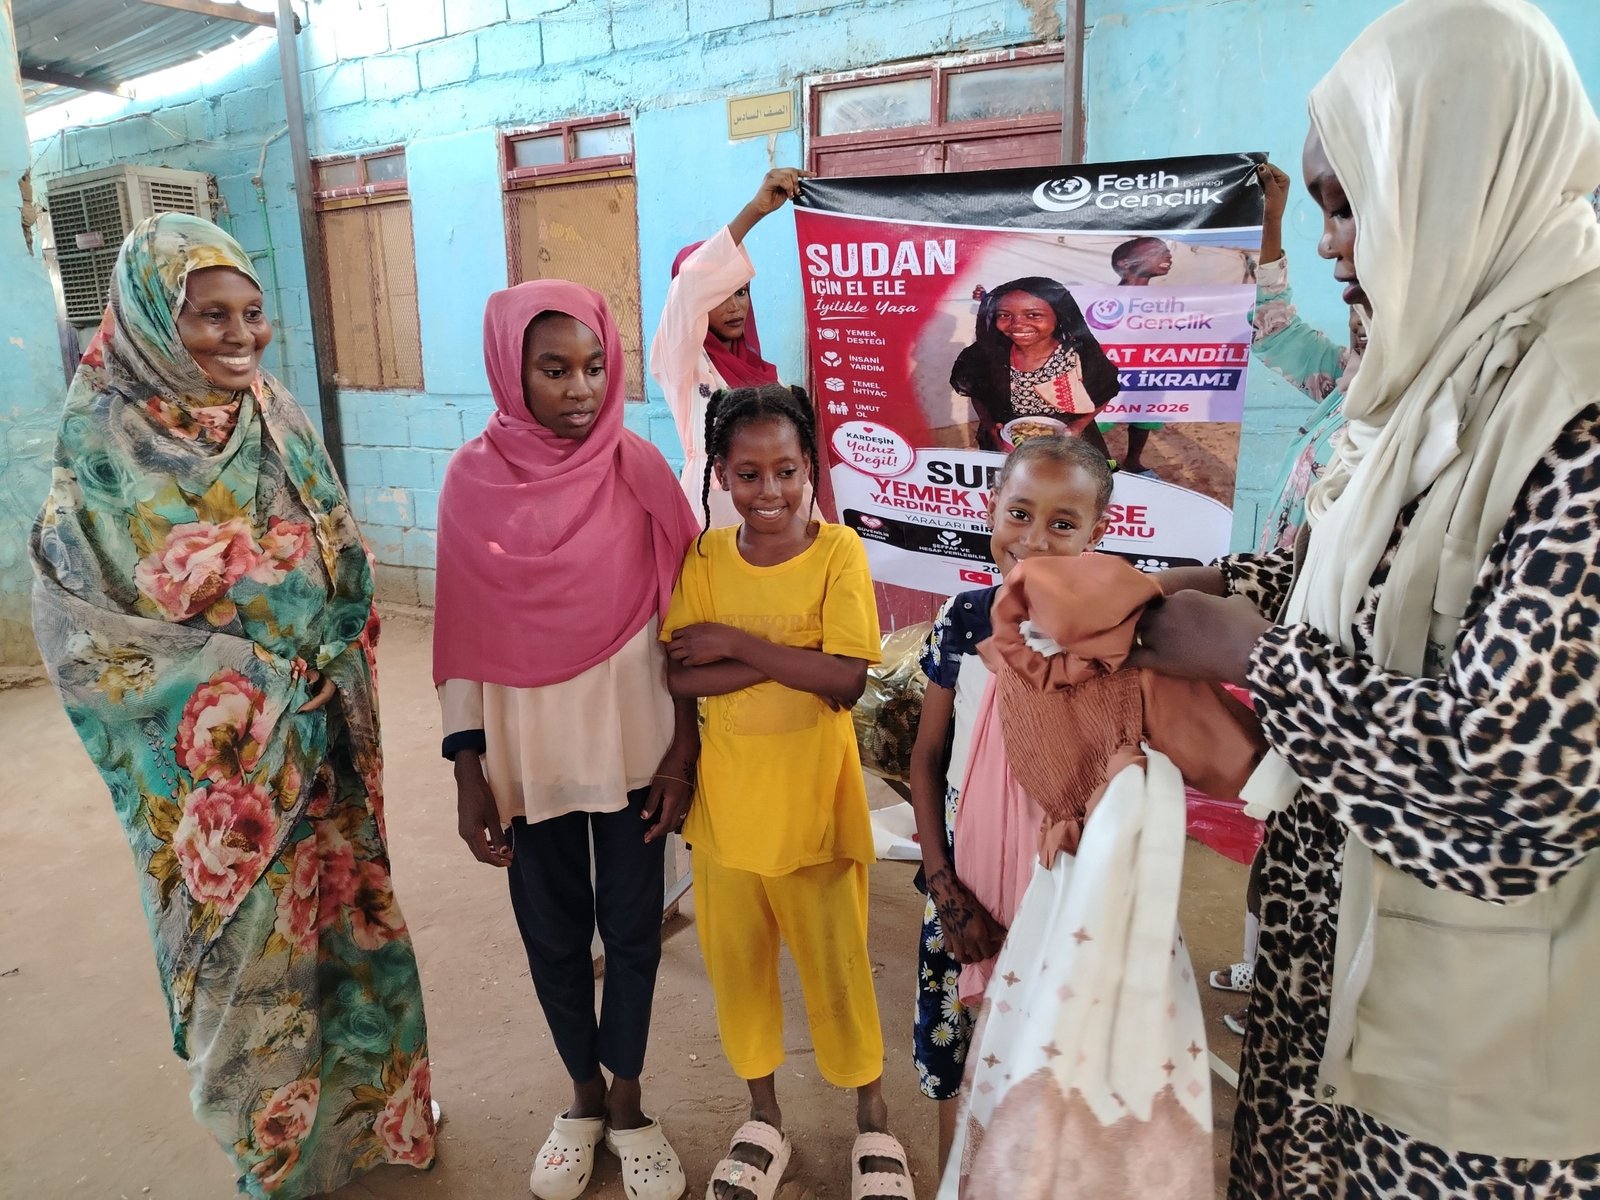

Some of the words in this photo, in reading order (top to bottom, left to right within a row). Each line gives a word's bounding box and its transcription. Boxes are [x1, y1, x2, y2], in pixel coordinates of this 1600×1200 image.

[733, 108, 762, 125] السادس
[763, 104, 788, 117] الصف
[1098, 171, 1179, 192] Fetih
[1095, 188, 1224, 210] Gençlik
[806, 239, 956, 278] SUDAN
[810, 277, 842, 296] İÇİN
[846, 280, 868, 296] EL
[872, 280, 906, 296] ELE
[813, 297, 870, 316] İyilikle
[875, 301, 919, 316] Yaşa
[1128, 296, 1185, 313] Fetih
[1126, 314, 1214, 331] Gençlik
[845, 328, 877, 337] YEMEK
[1143, 344, 1249, 363] KANDİLİ
[850, 363, 885, 372] YARDIM
[852, 380, 881, 389] TEMEL
[1137, 371, 1233, 387] İKRAMI
[855, 403, 881, 412] UMUT
[1146, 404, 1189, 413] 2026
[846, 432, 895, 445] KARDEŞİN
[852, 452, 898, 469] Değil!
[873, 476, 972, 508] YEMEK
[870, 492, 942, 514] YARDIM
[905, 514, 966, 530] YARALARI
